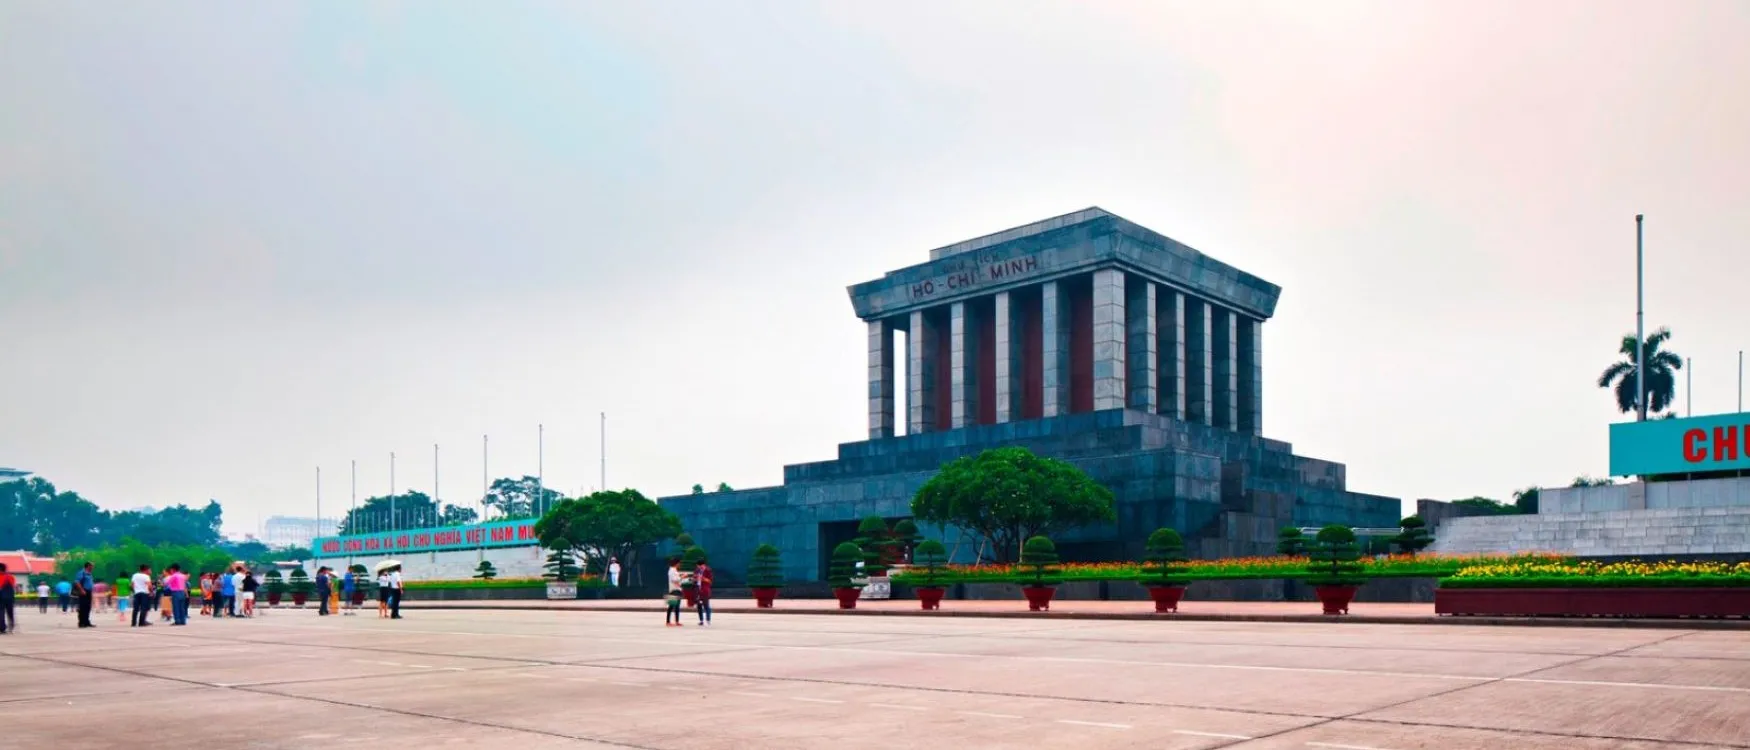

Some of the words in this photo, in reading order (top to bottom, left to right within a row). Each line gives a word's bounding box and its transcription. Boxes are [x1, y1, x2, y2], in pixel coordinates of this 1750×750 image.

[990, 255, 1037, 280] MINH
[1683, 424, 1750, 462] CH
[491, 526, 513, 542] NAM
